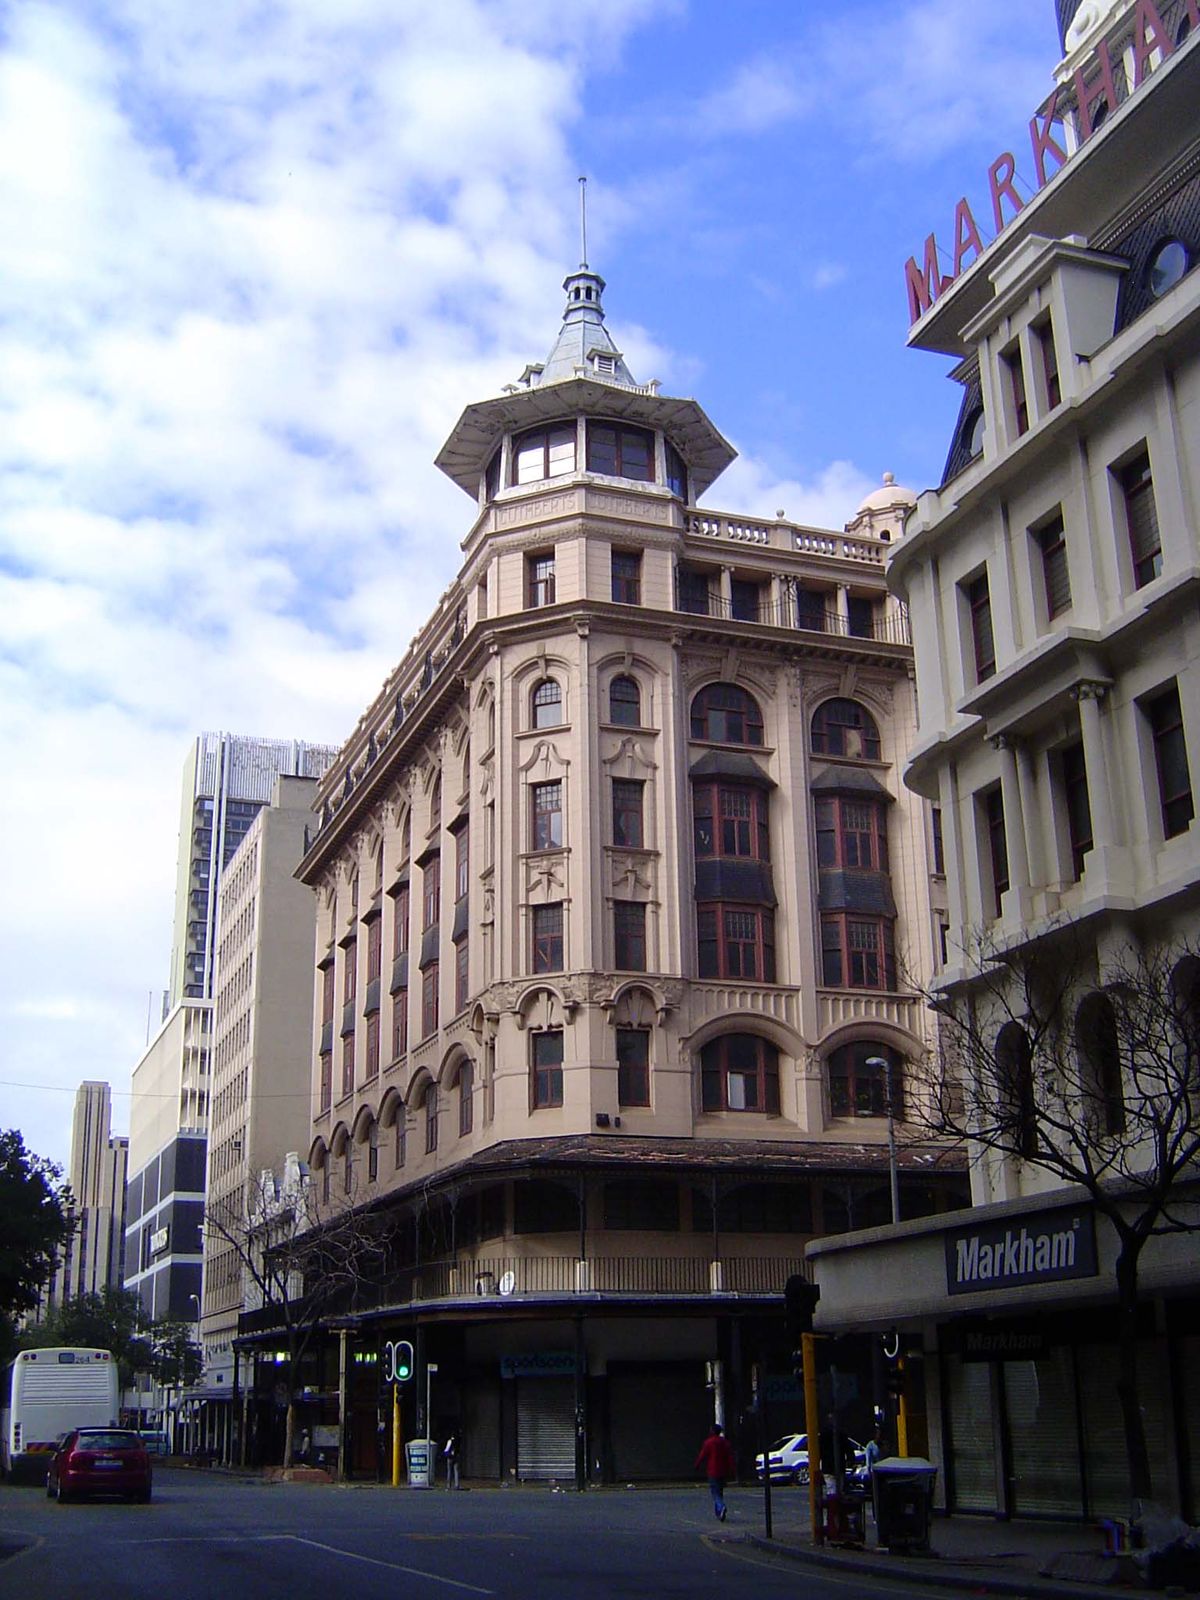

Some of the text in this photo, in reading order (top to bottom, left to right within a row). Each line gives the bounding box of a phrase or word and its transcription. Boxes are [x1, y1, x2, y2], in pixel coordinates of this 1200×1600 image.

[905, 0, 1200, 326] MARKHA
[956, 1228, 1075, 1282] Markham
[966, 1330, 1043, 1351] Markham
[503, 1352, 578, 1373] sportscen
